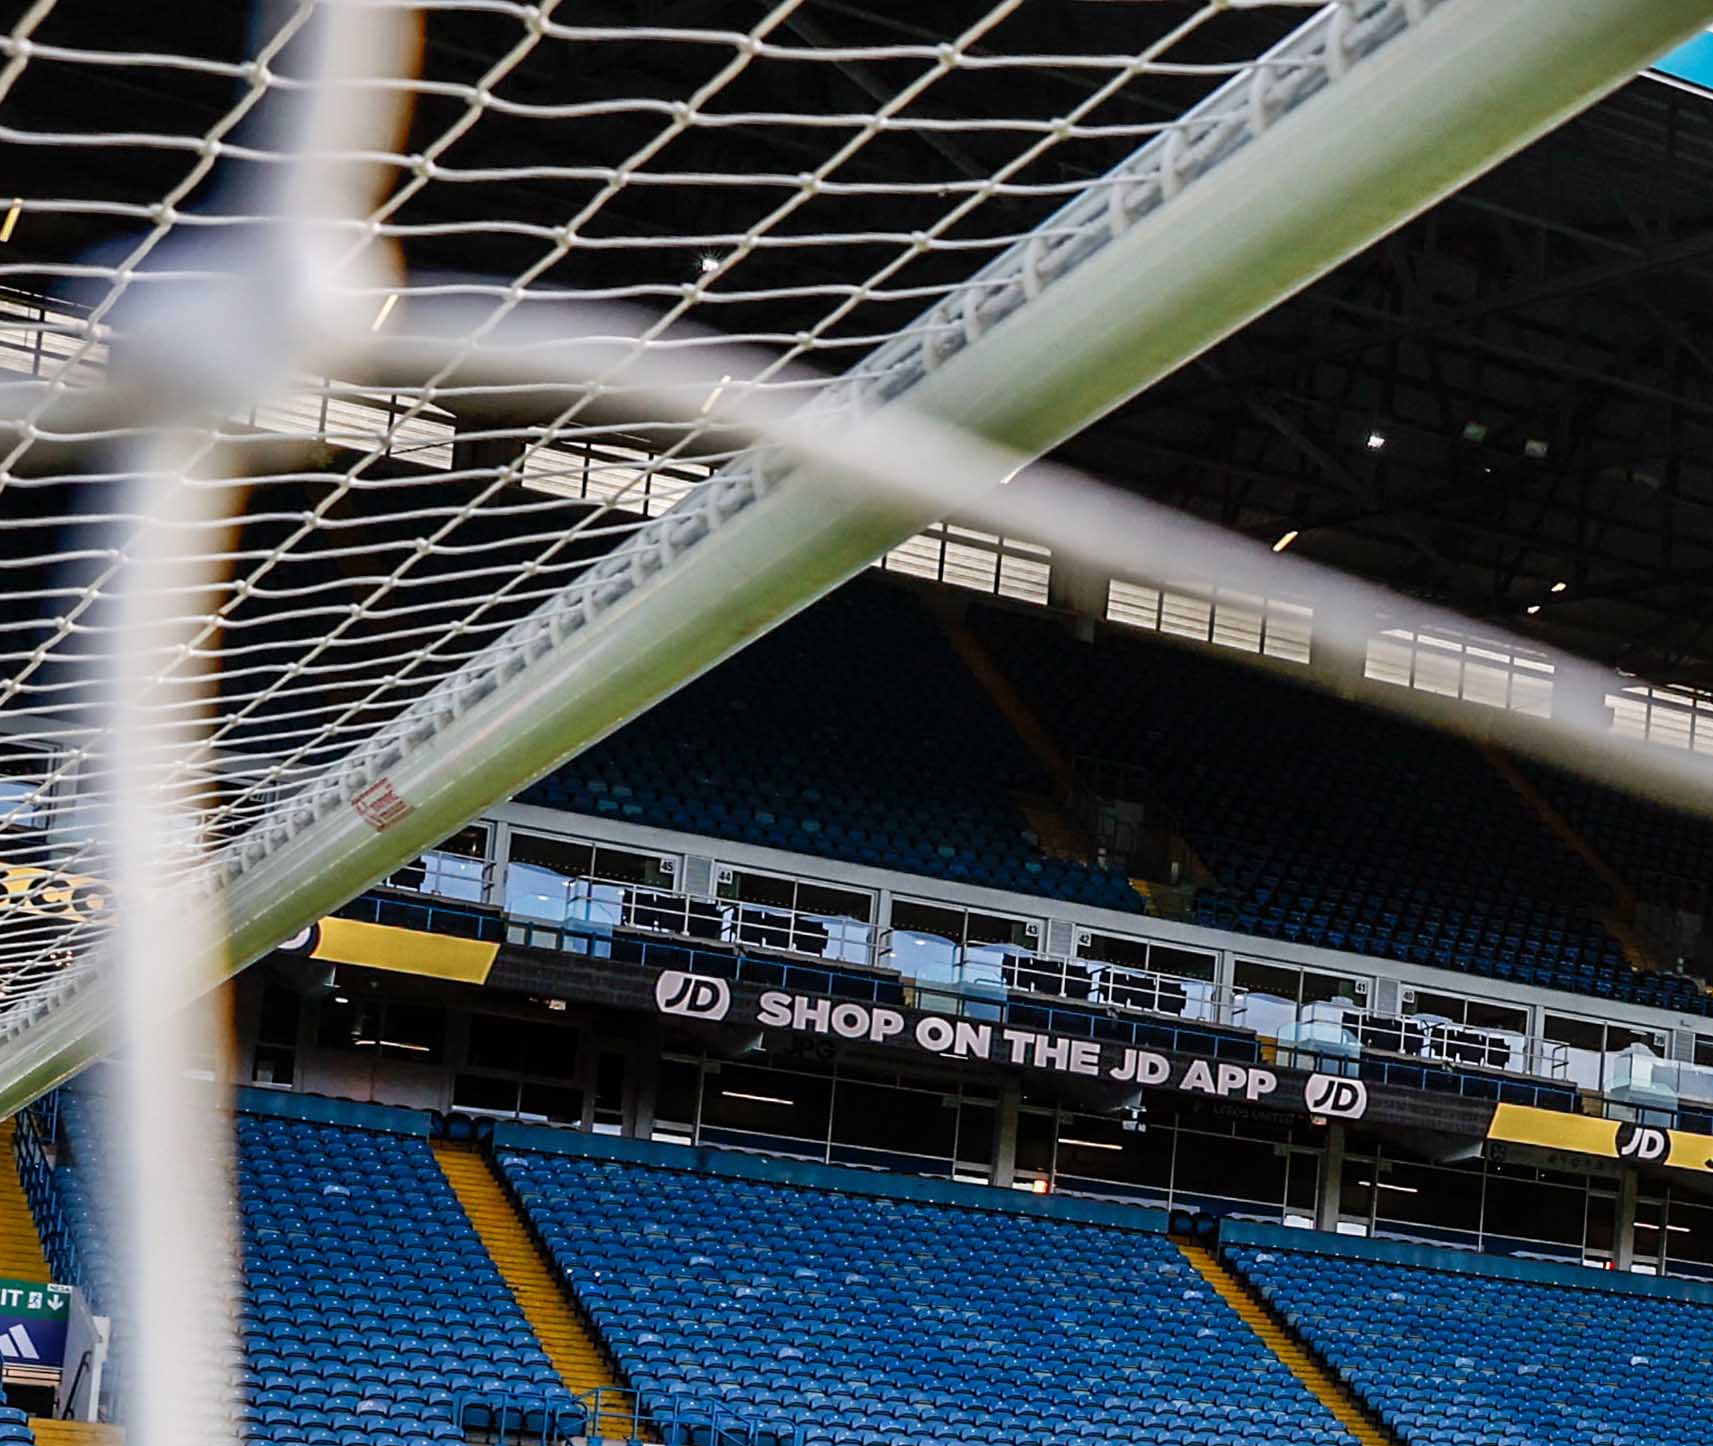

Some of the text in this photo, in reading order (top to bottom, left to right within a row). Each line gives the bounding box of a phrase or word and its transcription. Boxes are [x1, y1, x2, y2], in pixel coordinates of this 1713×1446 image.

[661, 860, 673, 872] 45
[719, 870, 731, 883] 44
[1026, 924, 1038, 936] 43
[1080, 933, 1090, 944] 42
[1357, 983, 1366, 992] 41
[664, 975, 1361, 1114] JD SHOP ON THE JD APP JD
[1621, 1126, 1666, 1160] JD
